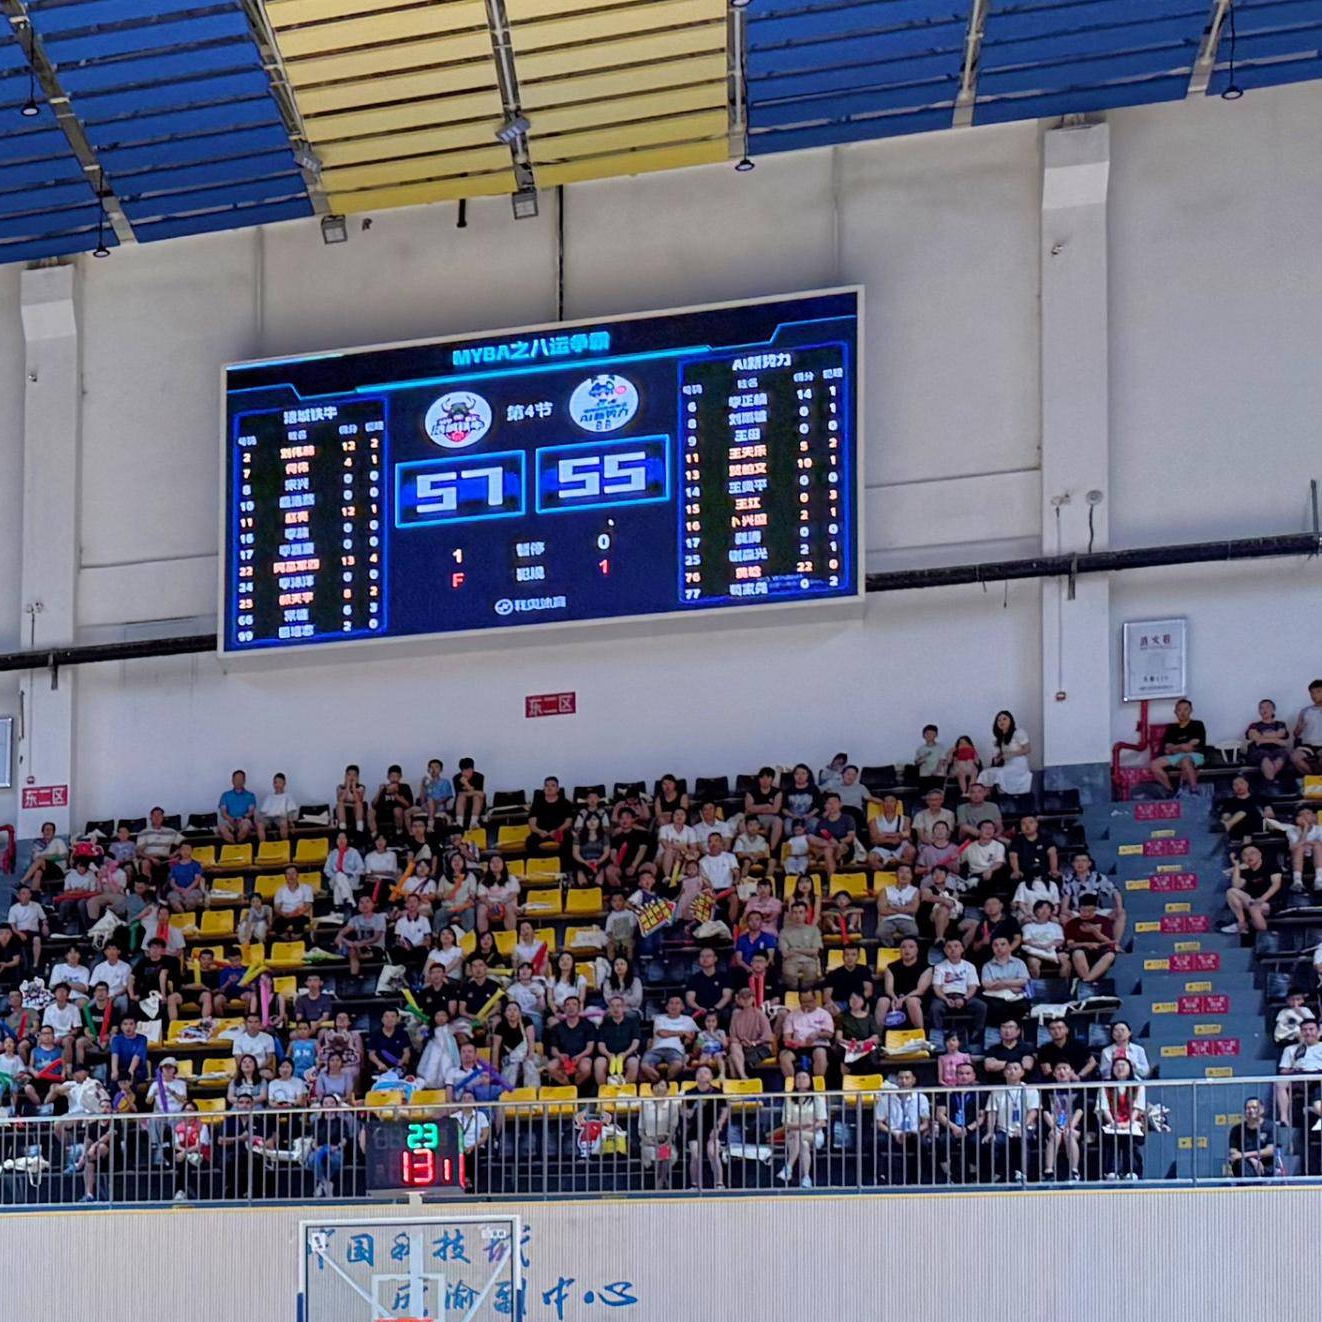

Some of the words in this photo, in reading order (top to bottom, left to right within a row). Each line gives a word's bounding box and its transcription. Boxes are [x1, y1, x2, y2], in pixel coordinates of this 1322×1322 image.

[506, 401, 554, 422] 第4节
[416, 466, 504, 514] 57
[558, 451, 646, 499] 55
[452, 548, 463, 564] 1
[597, 533, 611, 549] 0
[452, 572, 465, 588] F
[598, 559, 610, 574] 1
[527, 694, 574, 717] 东二区
[24, 786, 66, 808] 东二区
[407, 1123, 438, 1149] 23
